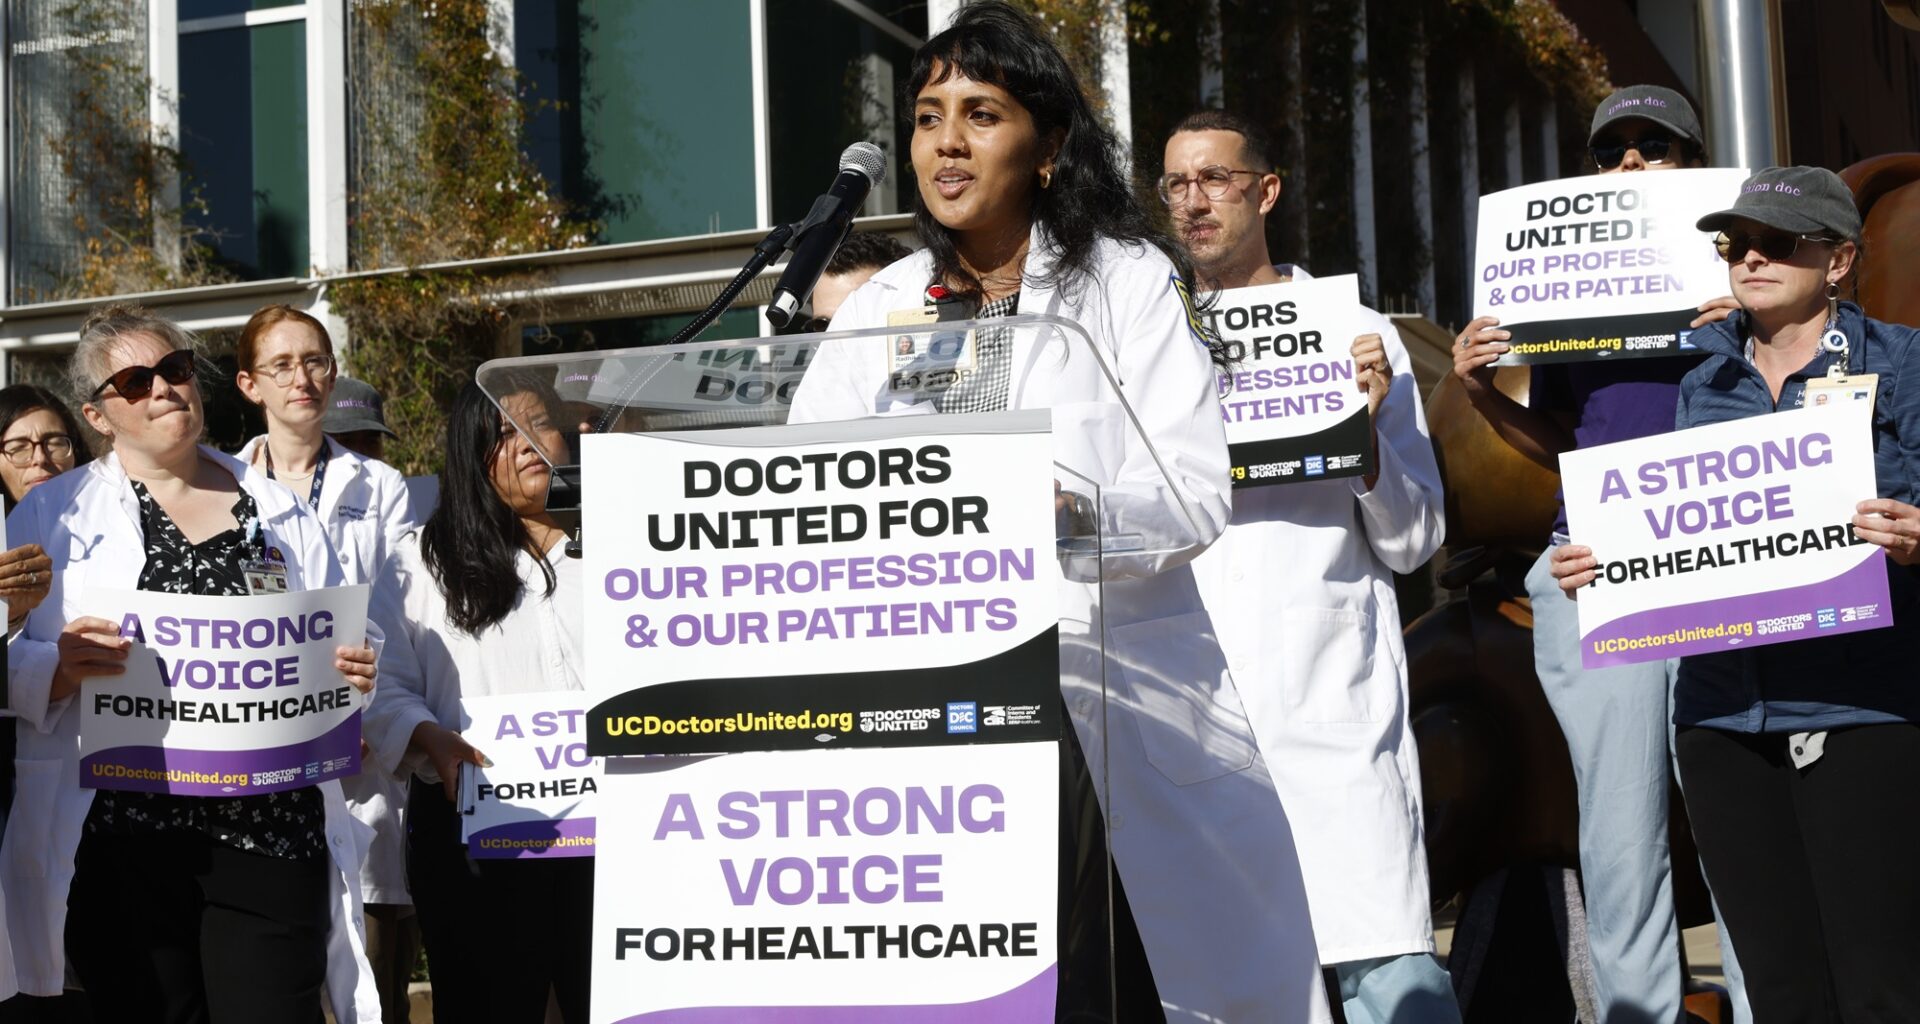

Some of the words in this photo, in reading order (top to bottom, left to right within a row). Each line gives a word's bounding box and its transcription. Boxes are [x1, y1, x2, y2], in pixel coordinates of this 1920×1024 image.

[1644, 96, 1667, 108] doc
[1775, 182, 1801, 196] doc
[1506, 219, 1634, 252] UNITED
[1483, 258, 1536, 283] OUR
[1489, 287, 1506, 306] &
[1510, 281, 1570, 304] OUR
[1253, 330, 1324, 360] FOR
[1634, 334, 1676, 345] DOCTORS
[1635, 341, 1668, 350] UNITED
[683, 444, 952, 499] DOCTORS
[1260, 460, 1301, 471] DOCTORS
[1260, 468, 1294, 478] UNITED
[1599, 468, 1632, 504] A
[1637, 432, 1833, 496] STRONG
[647, 503, 868, 552] UNITED
[879, 496, 990, 539] FOR
[1643, 484, 1794, 540] VOICE
[604, 566, 708, 601] OUR
[721, 547, 1035, 597] PROFESSION
[1588, 556, 1651, 588] FOR
[118, 612, 147, 644] A
[154, 610, 334, 649] STRONG
[624, 613, 659, 649] &
[666, 611, 769, 647] OUR
[777, 597, 1018, 643] PATIENTS
[1767, 613, 1812, 627] DOCTORS
[1768, 622, 1804, 634] UNITED
[1593, 621, 1753, 655] UCDoctorsUnited.org
[155, 655, 300, 691] VOICE
[94, 693, 155, 718] FOR
[157, 686, 351, 723] HEALTHCARE
[875, 708, 941, 721] DOCTORS
[495, 714, 525, 740] A
[606, 710, 853, 736] UCDoctorsUnited.org
[875, 720, 928, 732] UNITED
[92, 763, 248, 786] UCDoctorsUnited.org
[262, 767, 301, 779] DOCTORS
[262, 775, 294, 785] UNITED
[477, 782, 536, 801] FOR
[653, 793, 705, 840] A
[717, 783, 1005, 840] STRONG
[480, 835, 596, 848] UCDoctorsUnite
[719, 854, 944, 906] VOICE
[615, 927, 716, 962] FOR
[722, 922, 1038, 961] HEALTHCARE
